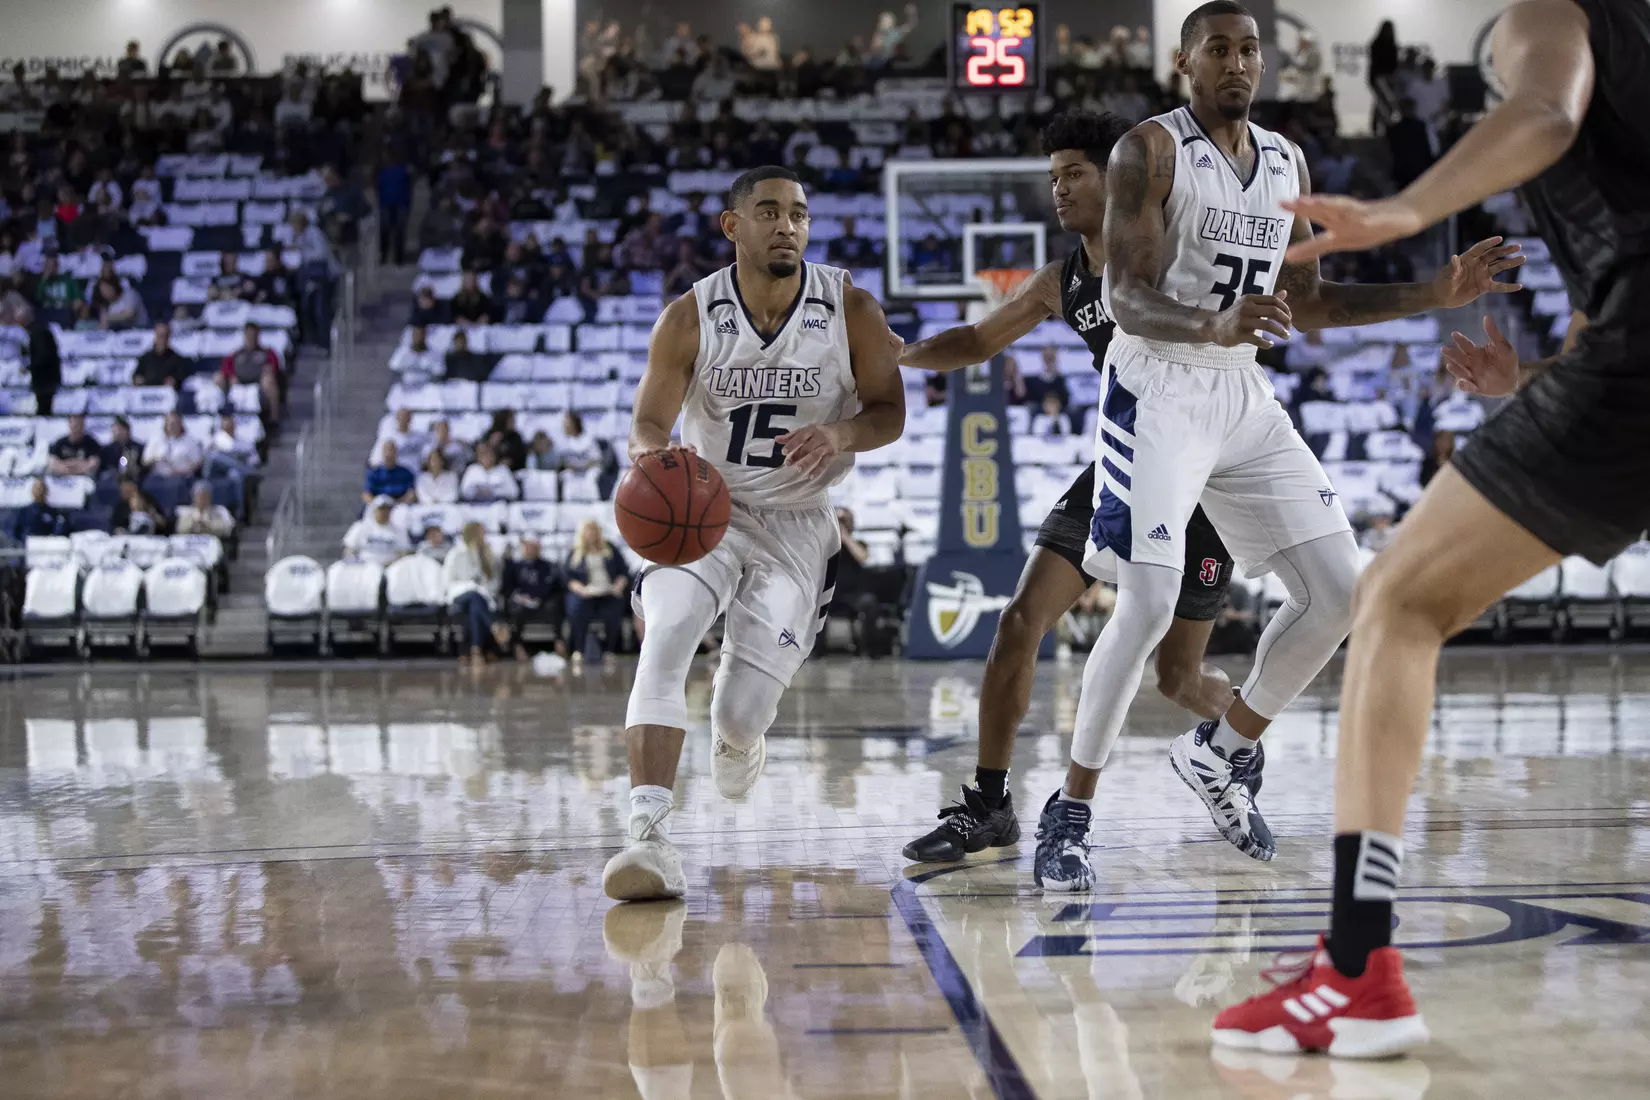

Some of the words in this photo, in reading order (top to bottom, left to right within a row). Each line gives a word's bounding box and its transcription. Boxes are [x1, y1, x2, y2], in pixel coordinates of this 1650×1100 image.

[966, 37, 1026, 87] 25
[1200, 207, 1286, 250] LANCERS
[716, 327, 740, 336] adidas
[802, 318, 828, 330] WAC
[709, 366, 821, 399] LANCERS
[725, 402, 798, 469] 15
[960, 411, 999, 548] CBU
[1147, 532, 1171, 541] adidas
